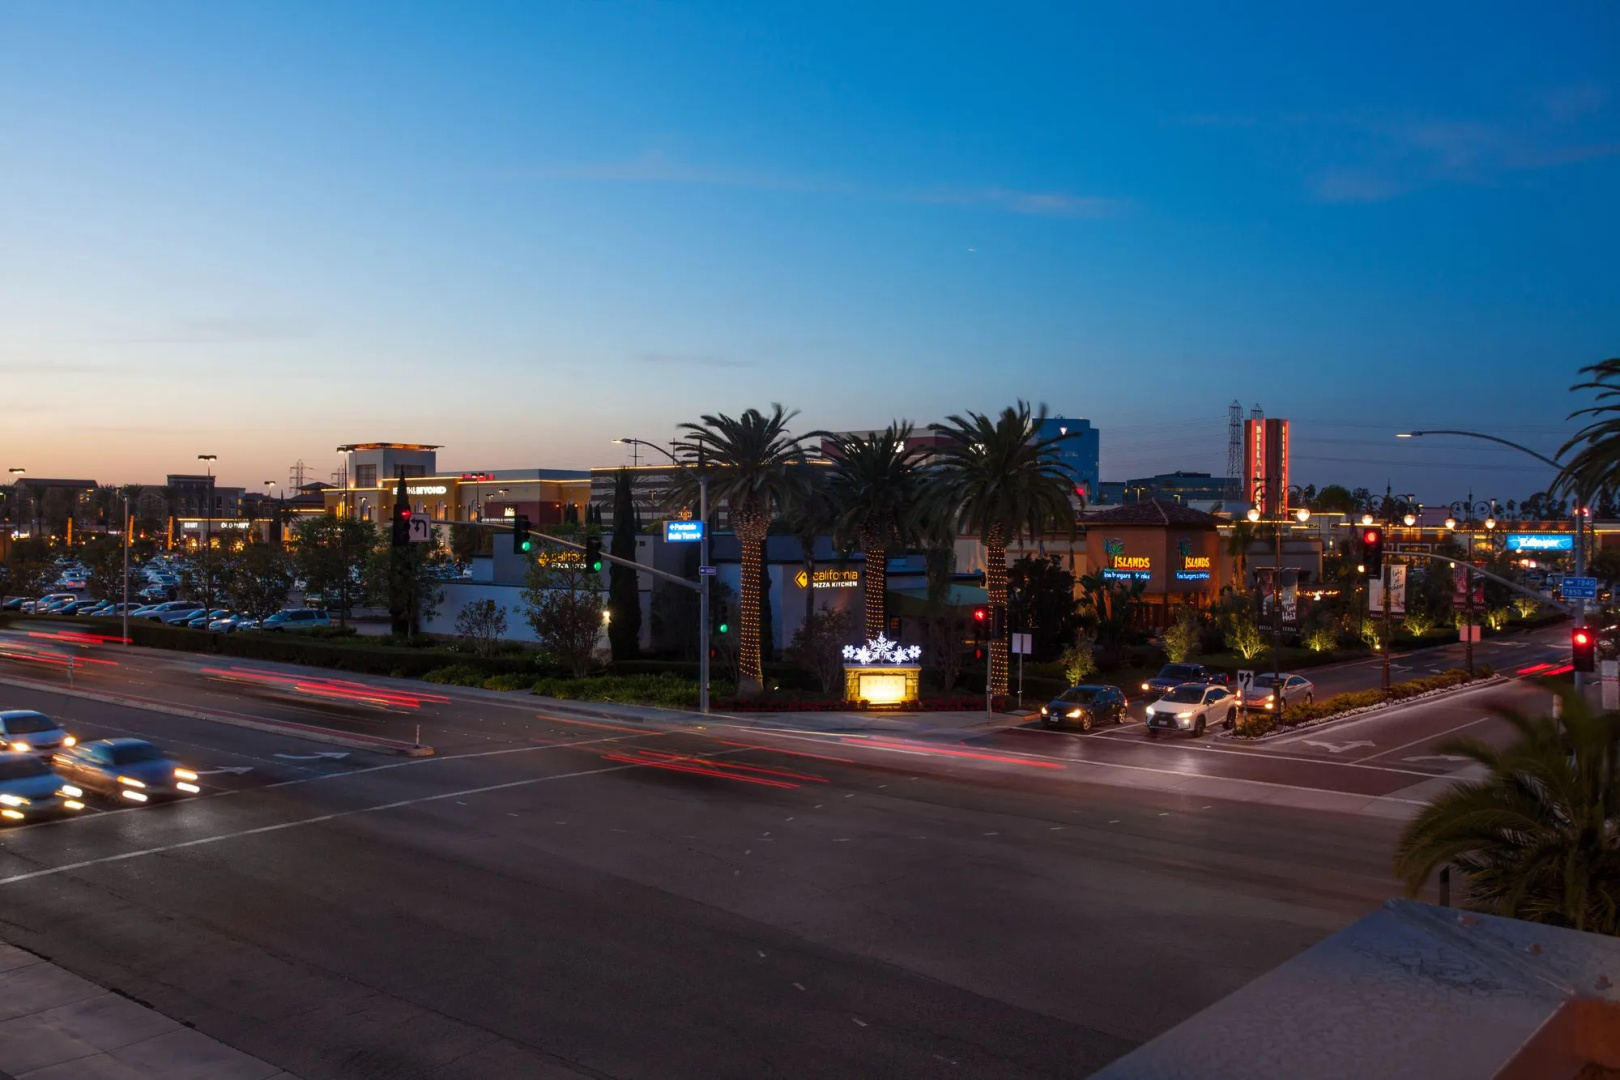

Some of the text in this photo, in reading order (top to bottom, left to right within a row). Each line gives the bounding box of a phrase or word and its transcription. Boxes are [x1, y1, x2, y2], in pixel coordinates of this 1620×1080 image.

[416, 486, 447, 495] BEYOND
[1114, 555, 1151, 568] ISLANDS
[1185, 556, 1210, 569] ISLANDS
[812, 569, 858, 581] california
